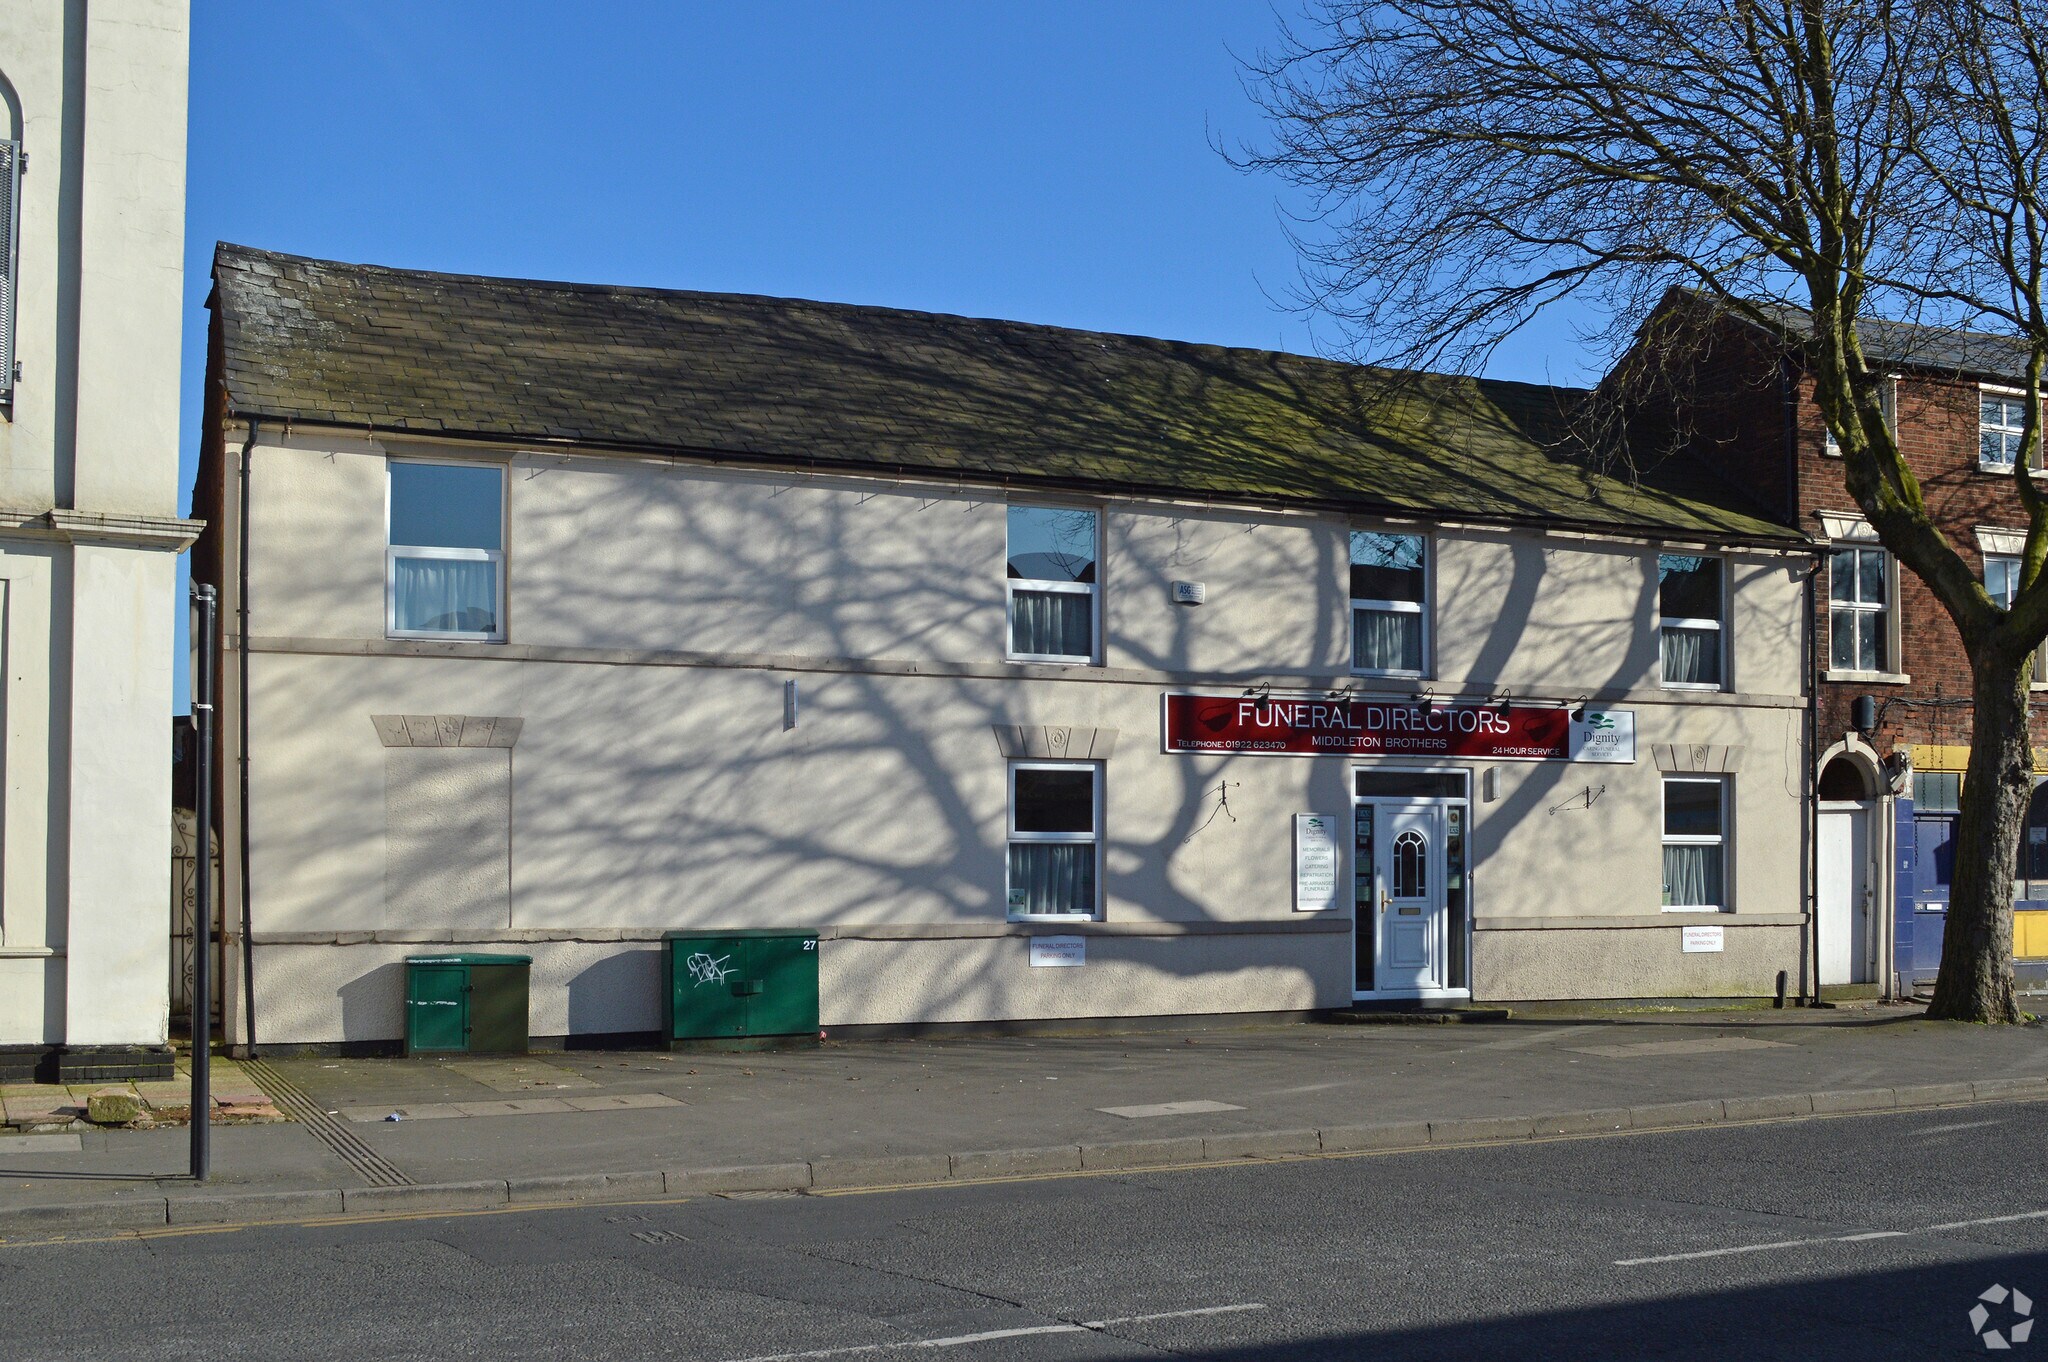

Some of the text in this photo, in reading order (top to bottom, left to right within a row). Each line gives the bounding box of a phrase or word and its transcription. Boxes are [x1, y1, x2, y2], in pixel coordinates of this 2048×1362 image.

[1238, 702, 1511, 734] FUNERAL DIRECTORS
[1311, 735, 1447, 749] MIDDLETON BROTHERS
[1583, 731, 1620, 746] Dignity
[1225, 740, 1252, 749] 01922
[1253, 741, 1286, 750] 623470
[1492, 746, 1560, 756] 24 HOUR SERVICE
[803, 940, 817, 950] 27
